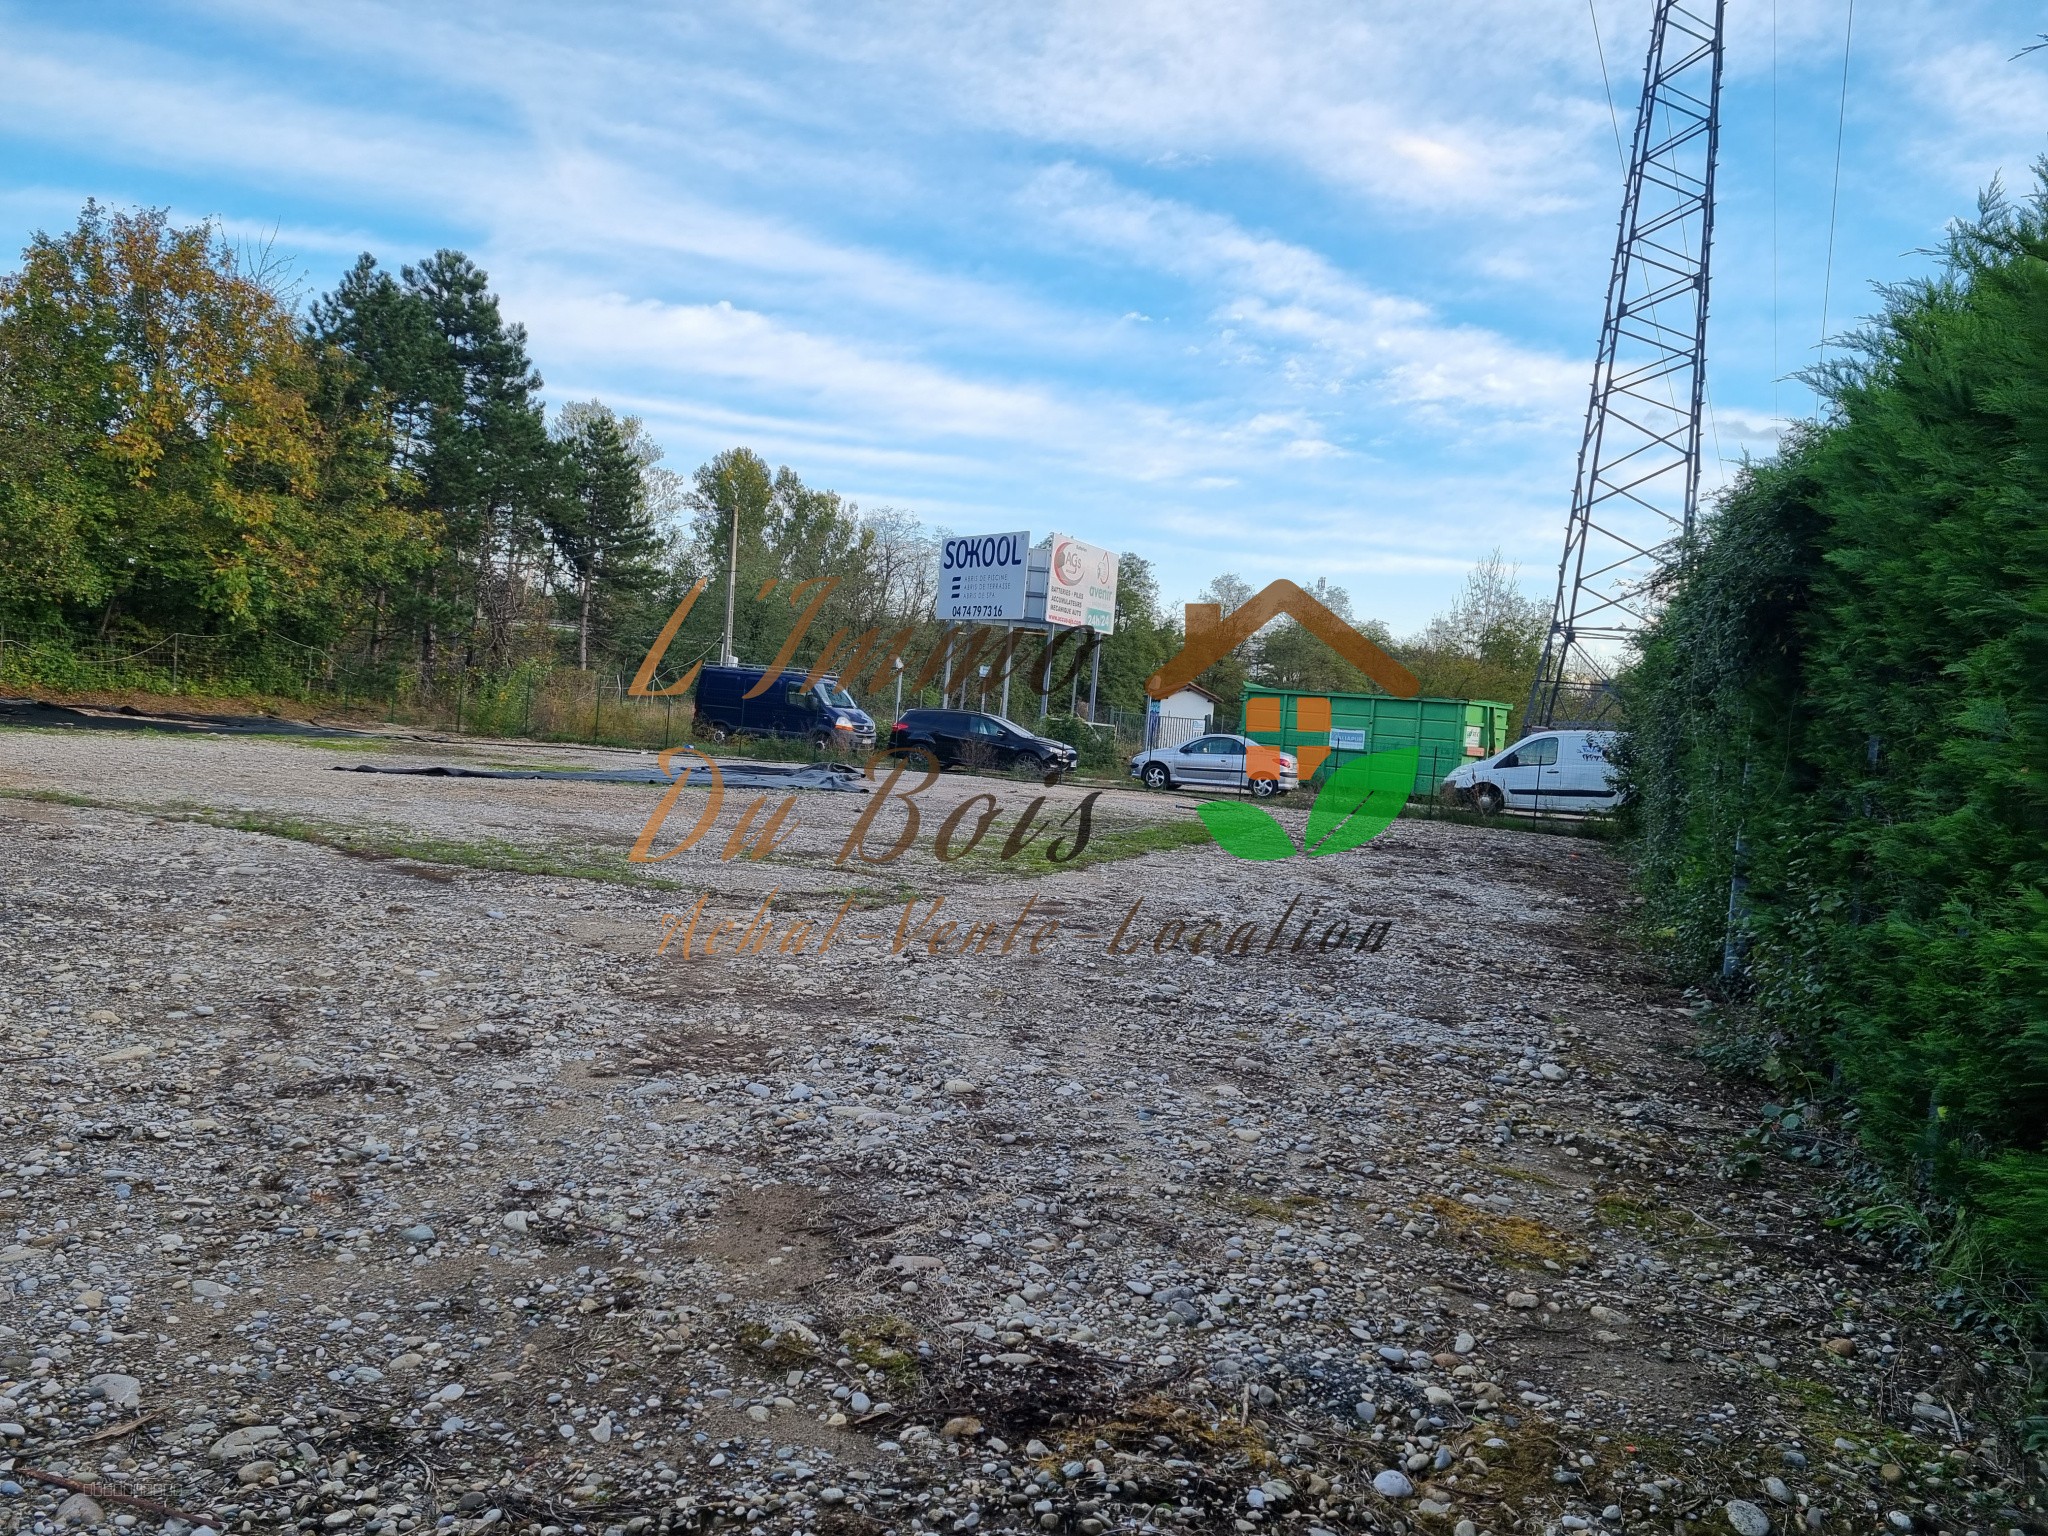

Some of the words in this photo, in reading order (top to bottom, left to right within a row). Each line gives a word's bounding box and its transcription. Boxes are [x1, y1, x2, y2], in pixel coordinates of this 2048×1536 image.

[943, 534, 1022, 569] SOKOOL
[964, 575, 978, 583] ABRIS
[979, 574, 986, 582] DE
[988, 573, 1008, 581] PISCINE
[963, 583, 978, 591] ABRIS
[987, 582, 1011, 590] TERRASSE
[1051, 585, 1071, 596] BATTERIES
[1073, 591, 1084, 600] PILES
[1089, 585, 1113, 601] avenir
[1050, 596, 1082, 608] ACCUMULATEURS
[1072, 608, 1082, 617] AUTO
